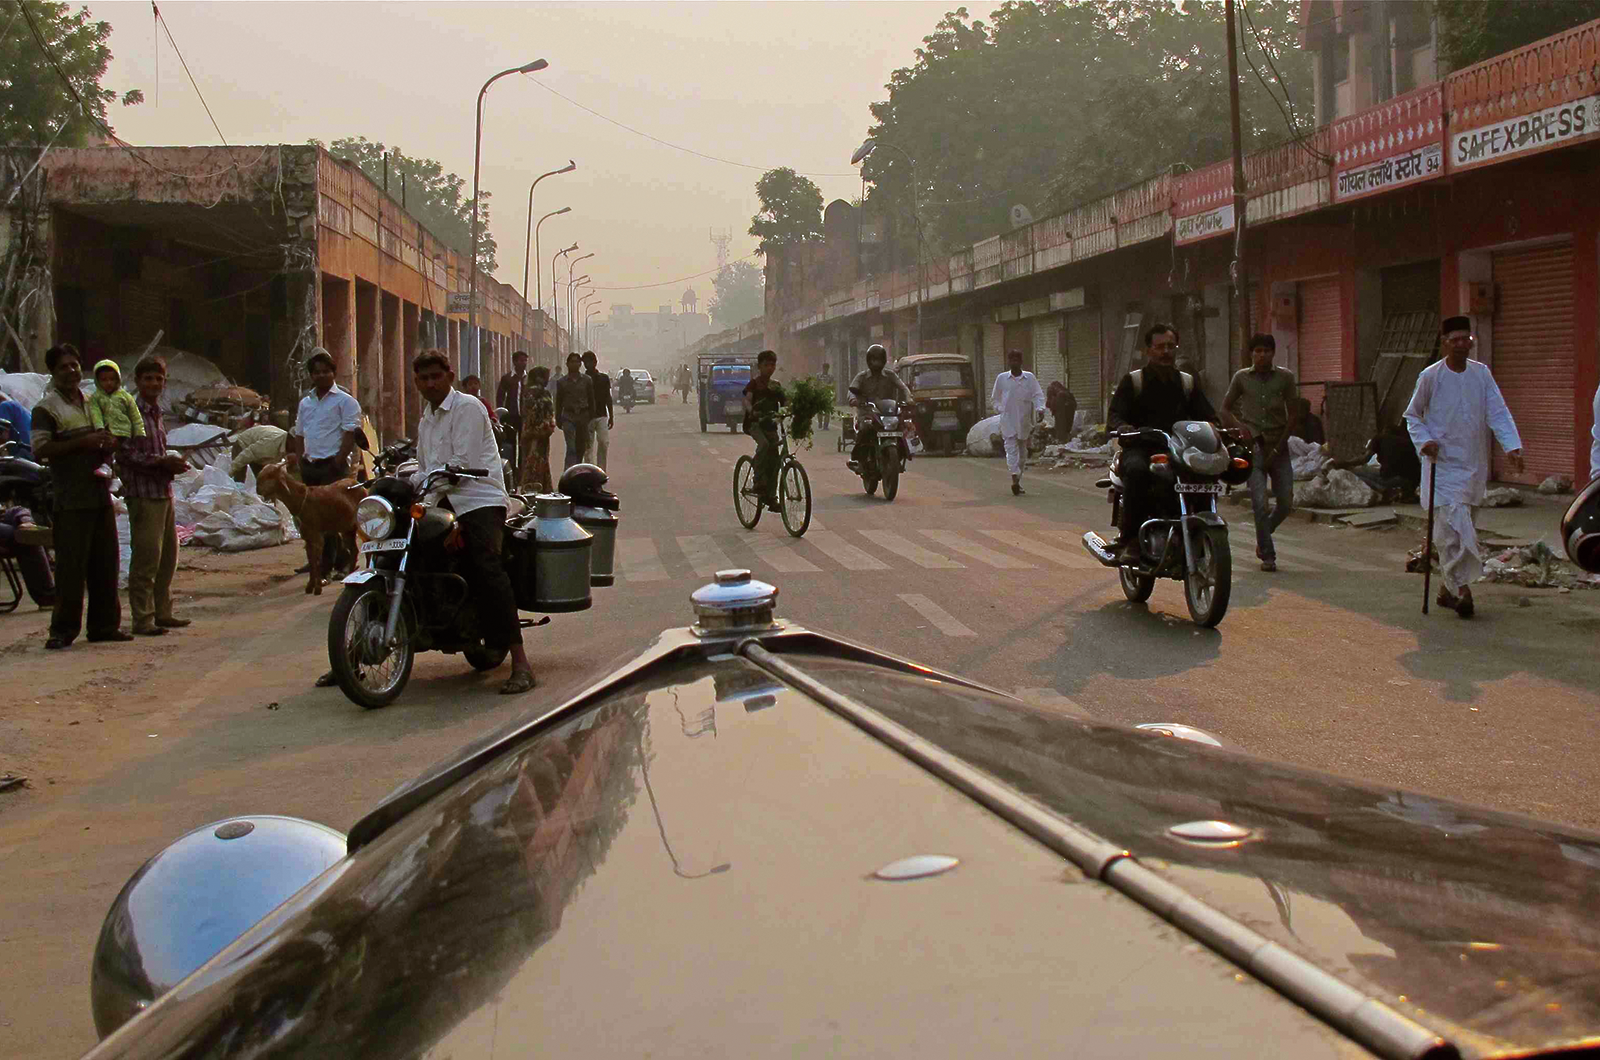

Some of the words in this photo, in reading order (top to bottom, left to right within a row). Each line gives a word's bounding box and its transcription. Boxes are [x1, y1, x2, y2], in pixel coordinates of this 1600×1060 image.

[1458, 105, 1586, 162] SAFEXPRESS
[1395, 152, 1422, 180] स्टोर
[1426, 156, 1440, 173] 94
